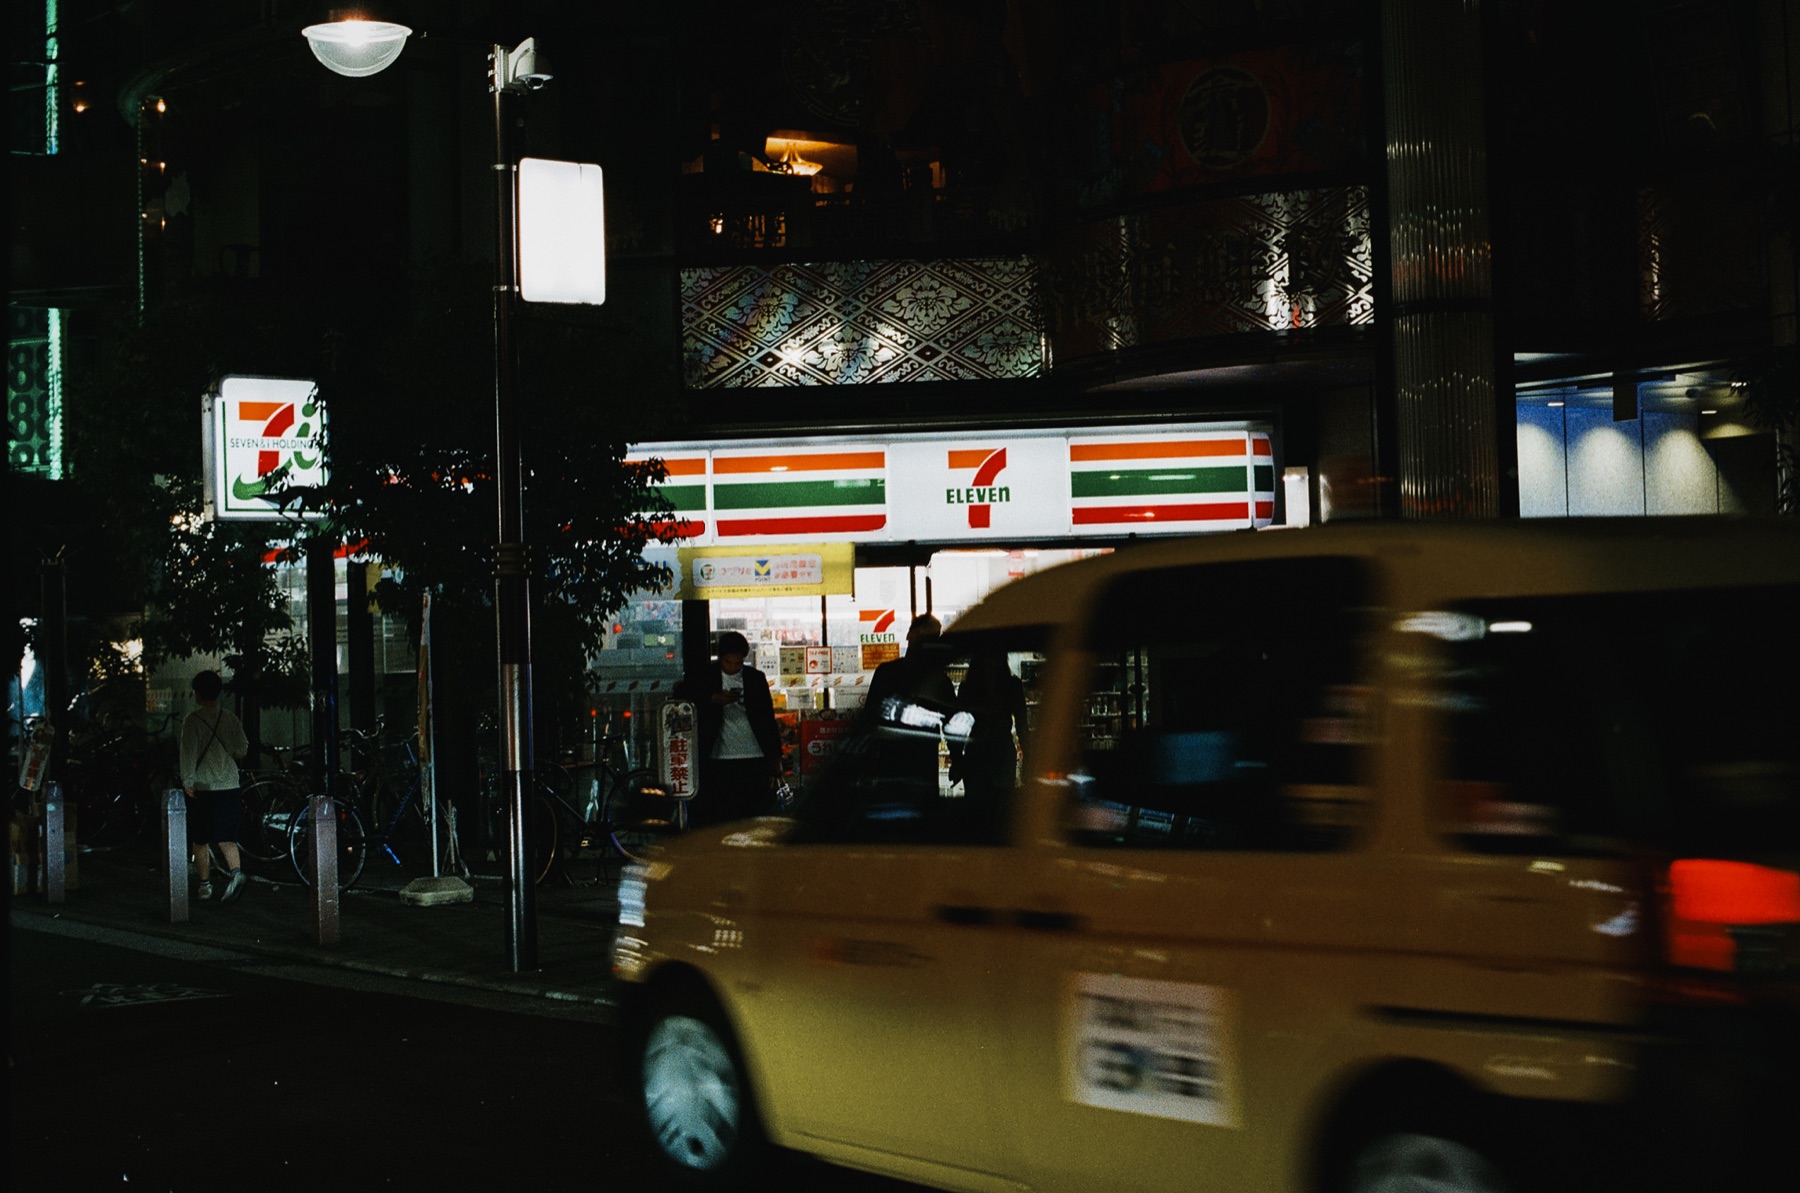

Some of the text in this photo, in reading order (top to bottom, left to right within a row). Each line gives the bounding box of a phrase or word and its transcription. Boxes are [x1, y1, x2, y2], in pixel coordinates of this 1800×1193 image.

[238, 401, 295, 479] 7
[948, 447, 1007, 529] 7
[669, 739, 689, 794] 駐車禁止
